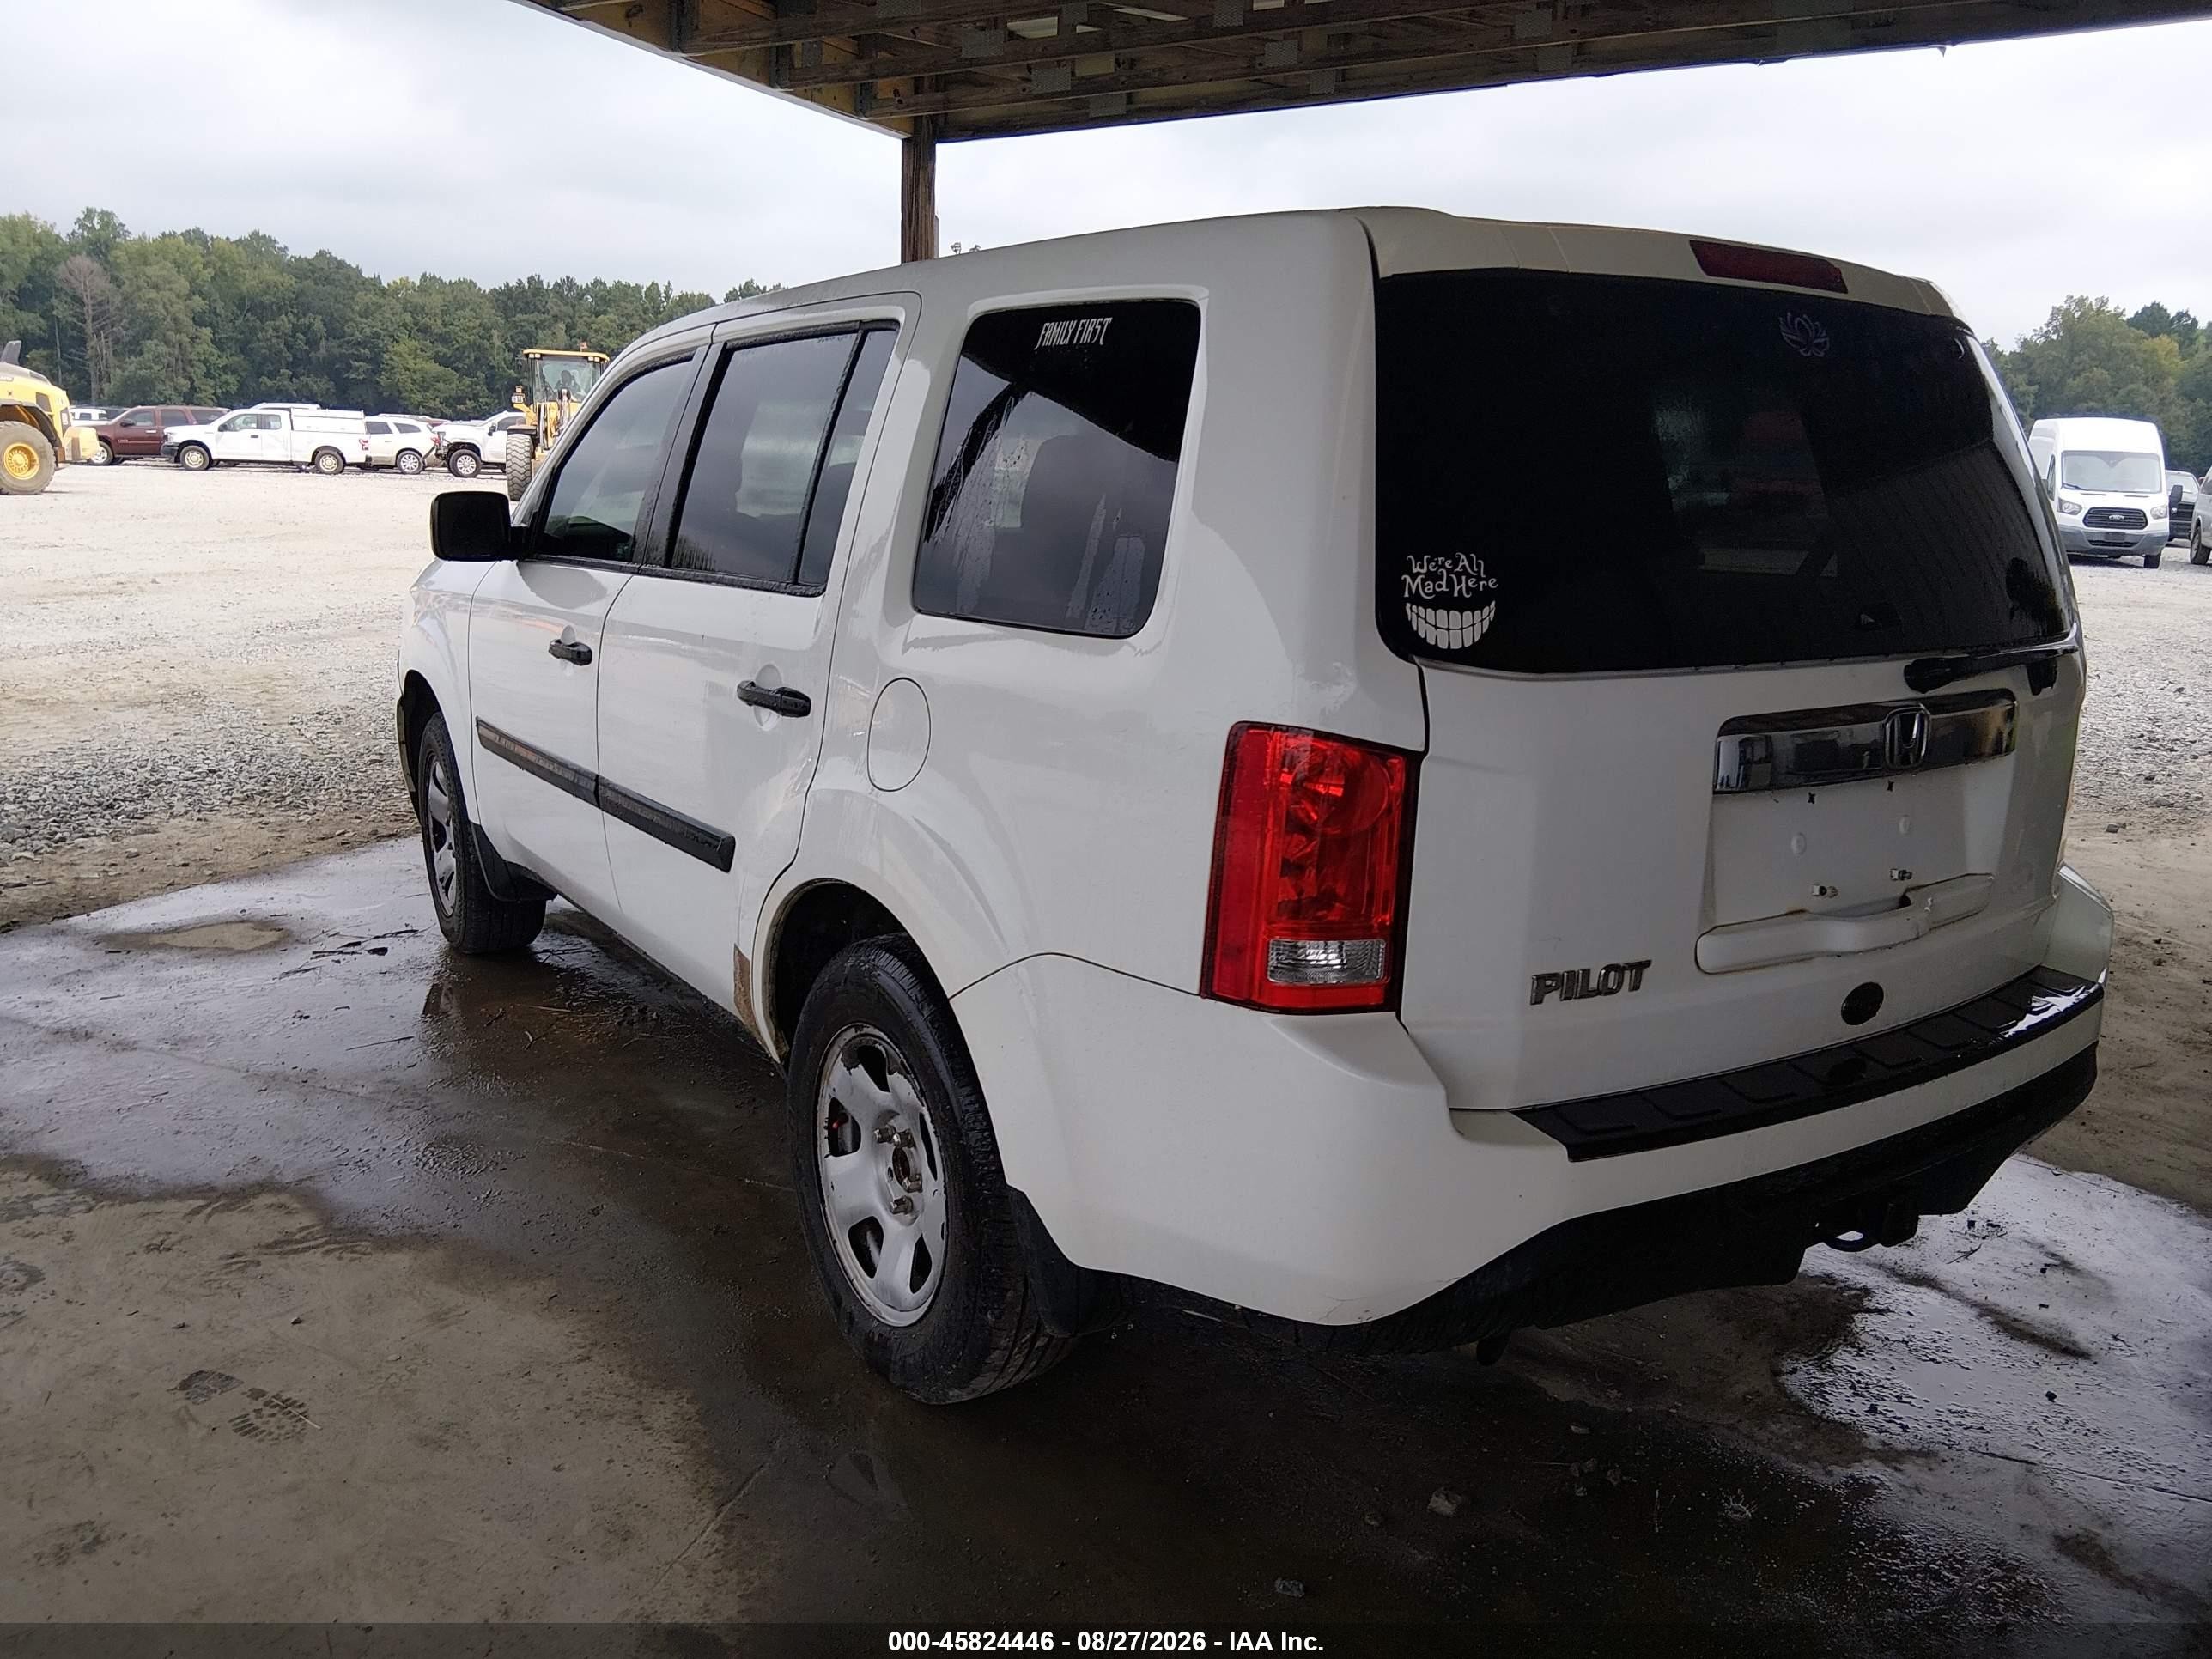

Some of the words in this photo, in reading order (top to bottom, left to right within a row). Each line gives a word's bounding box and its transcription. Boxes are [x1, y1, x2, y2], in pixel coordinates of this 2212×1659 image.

[1033, 319, 1078, 350] FAMILY
[1073, 317, 1113, 346] FIRST
[1454, 552, 1486, 578] All
[1401, 568, 1449, 599] Mad
[1449, 574, 1498, 599] Here
[1530, 959, 1652, 1006] PILOT
